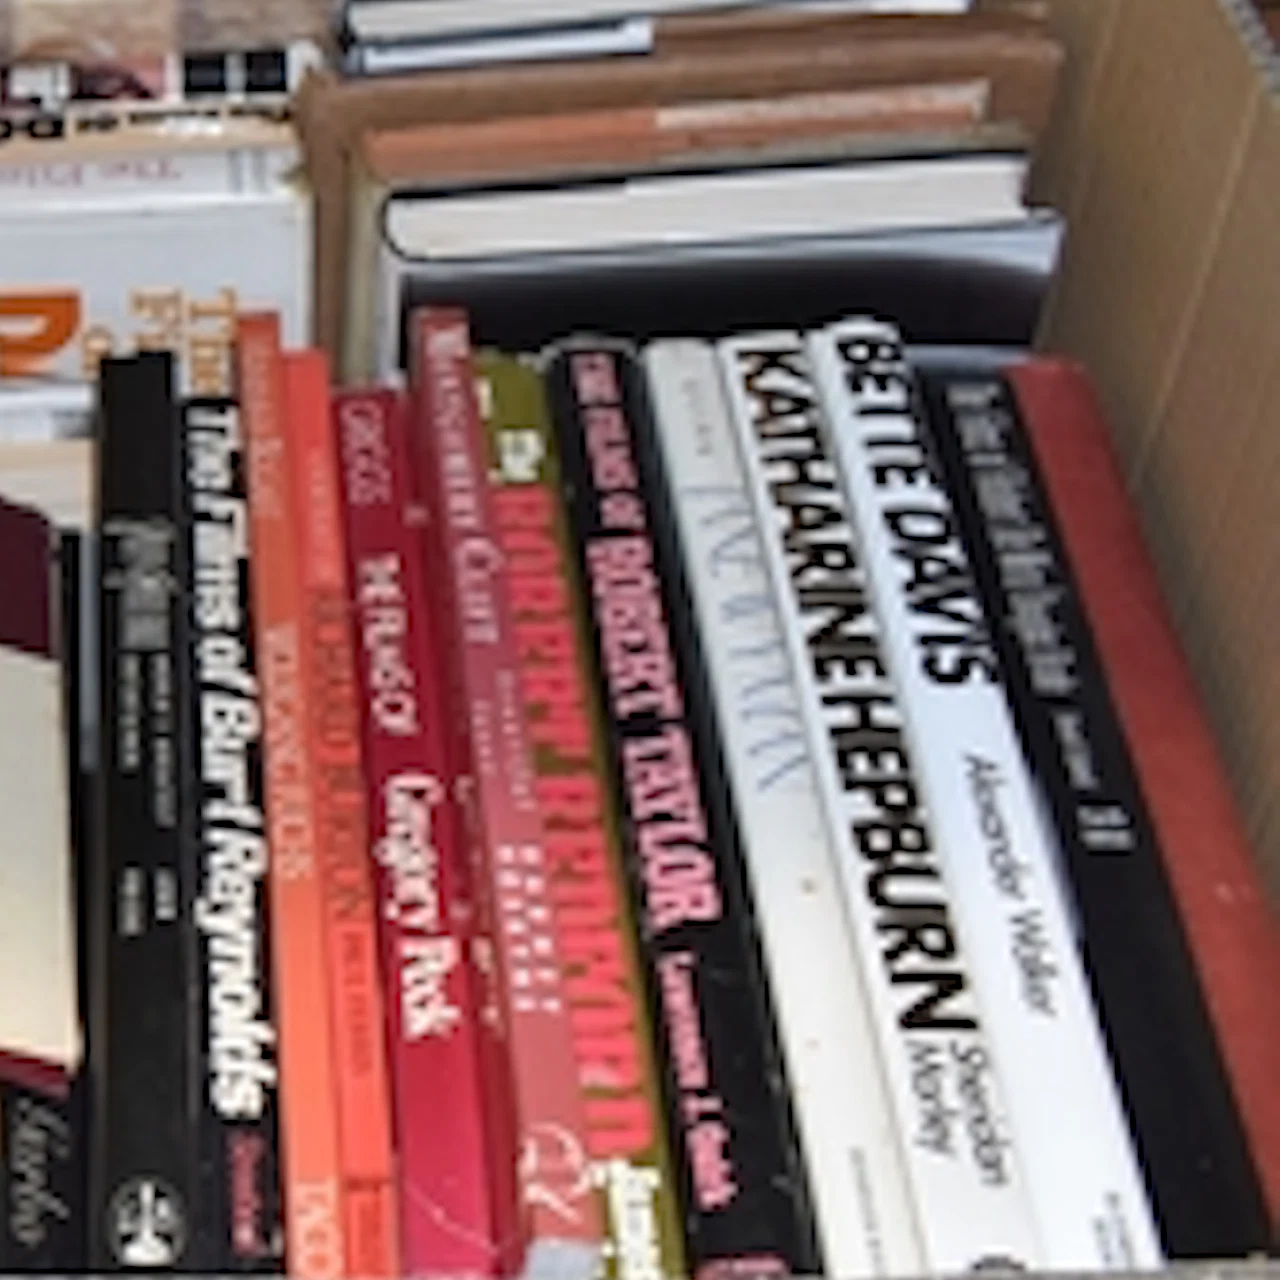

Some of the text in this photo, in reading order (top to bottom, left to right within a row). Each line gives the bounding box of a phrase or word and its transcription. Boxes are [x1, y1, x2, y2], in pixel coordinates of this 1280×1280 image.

[185, 405, 239, 492] The
[570, 349, 621, 407] THE
[580, 402, 638, 494] FILMS
[182, 491, 248, 630] Films
[597, 488, 646, 531] OF
[831, 323, 999, 700] BETTE DAVIS
[194, 635, 253, 694] of
[489, 480, 594, 763] ROBERT
[578, 527, 684, 730] ROBERT
[732, 334, 981, 1047] KATHARINE HEPBURN
[193, 690, 262, 829] Burt
[359, 554, 463, 1040] THE FILMS OF Gregory Peck
[614, 722, 725, 933] TAYLOR
[191, 826, 279, 1121] Reynolds
[533, 771, 658, 1162] REDFORD
[955, 745, 1040, 909] Alexander
[999, 904, 1072, 1024] Walker
[894, 1034, 967, 1164] Morley
[945, 1034, 1018, 1190] Sheridan
